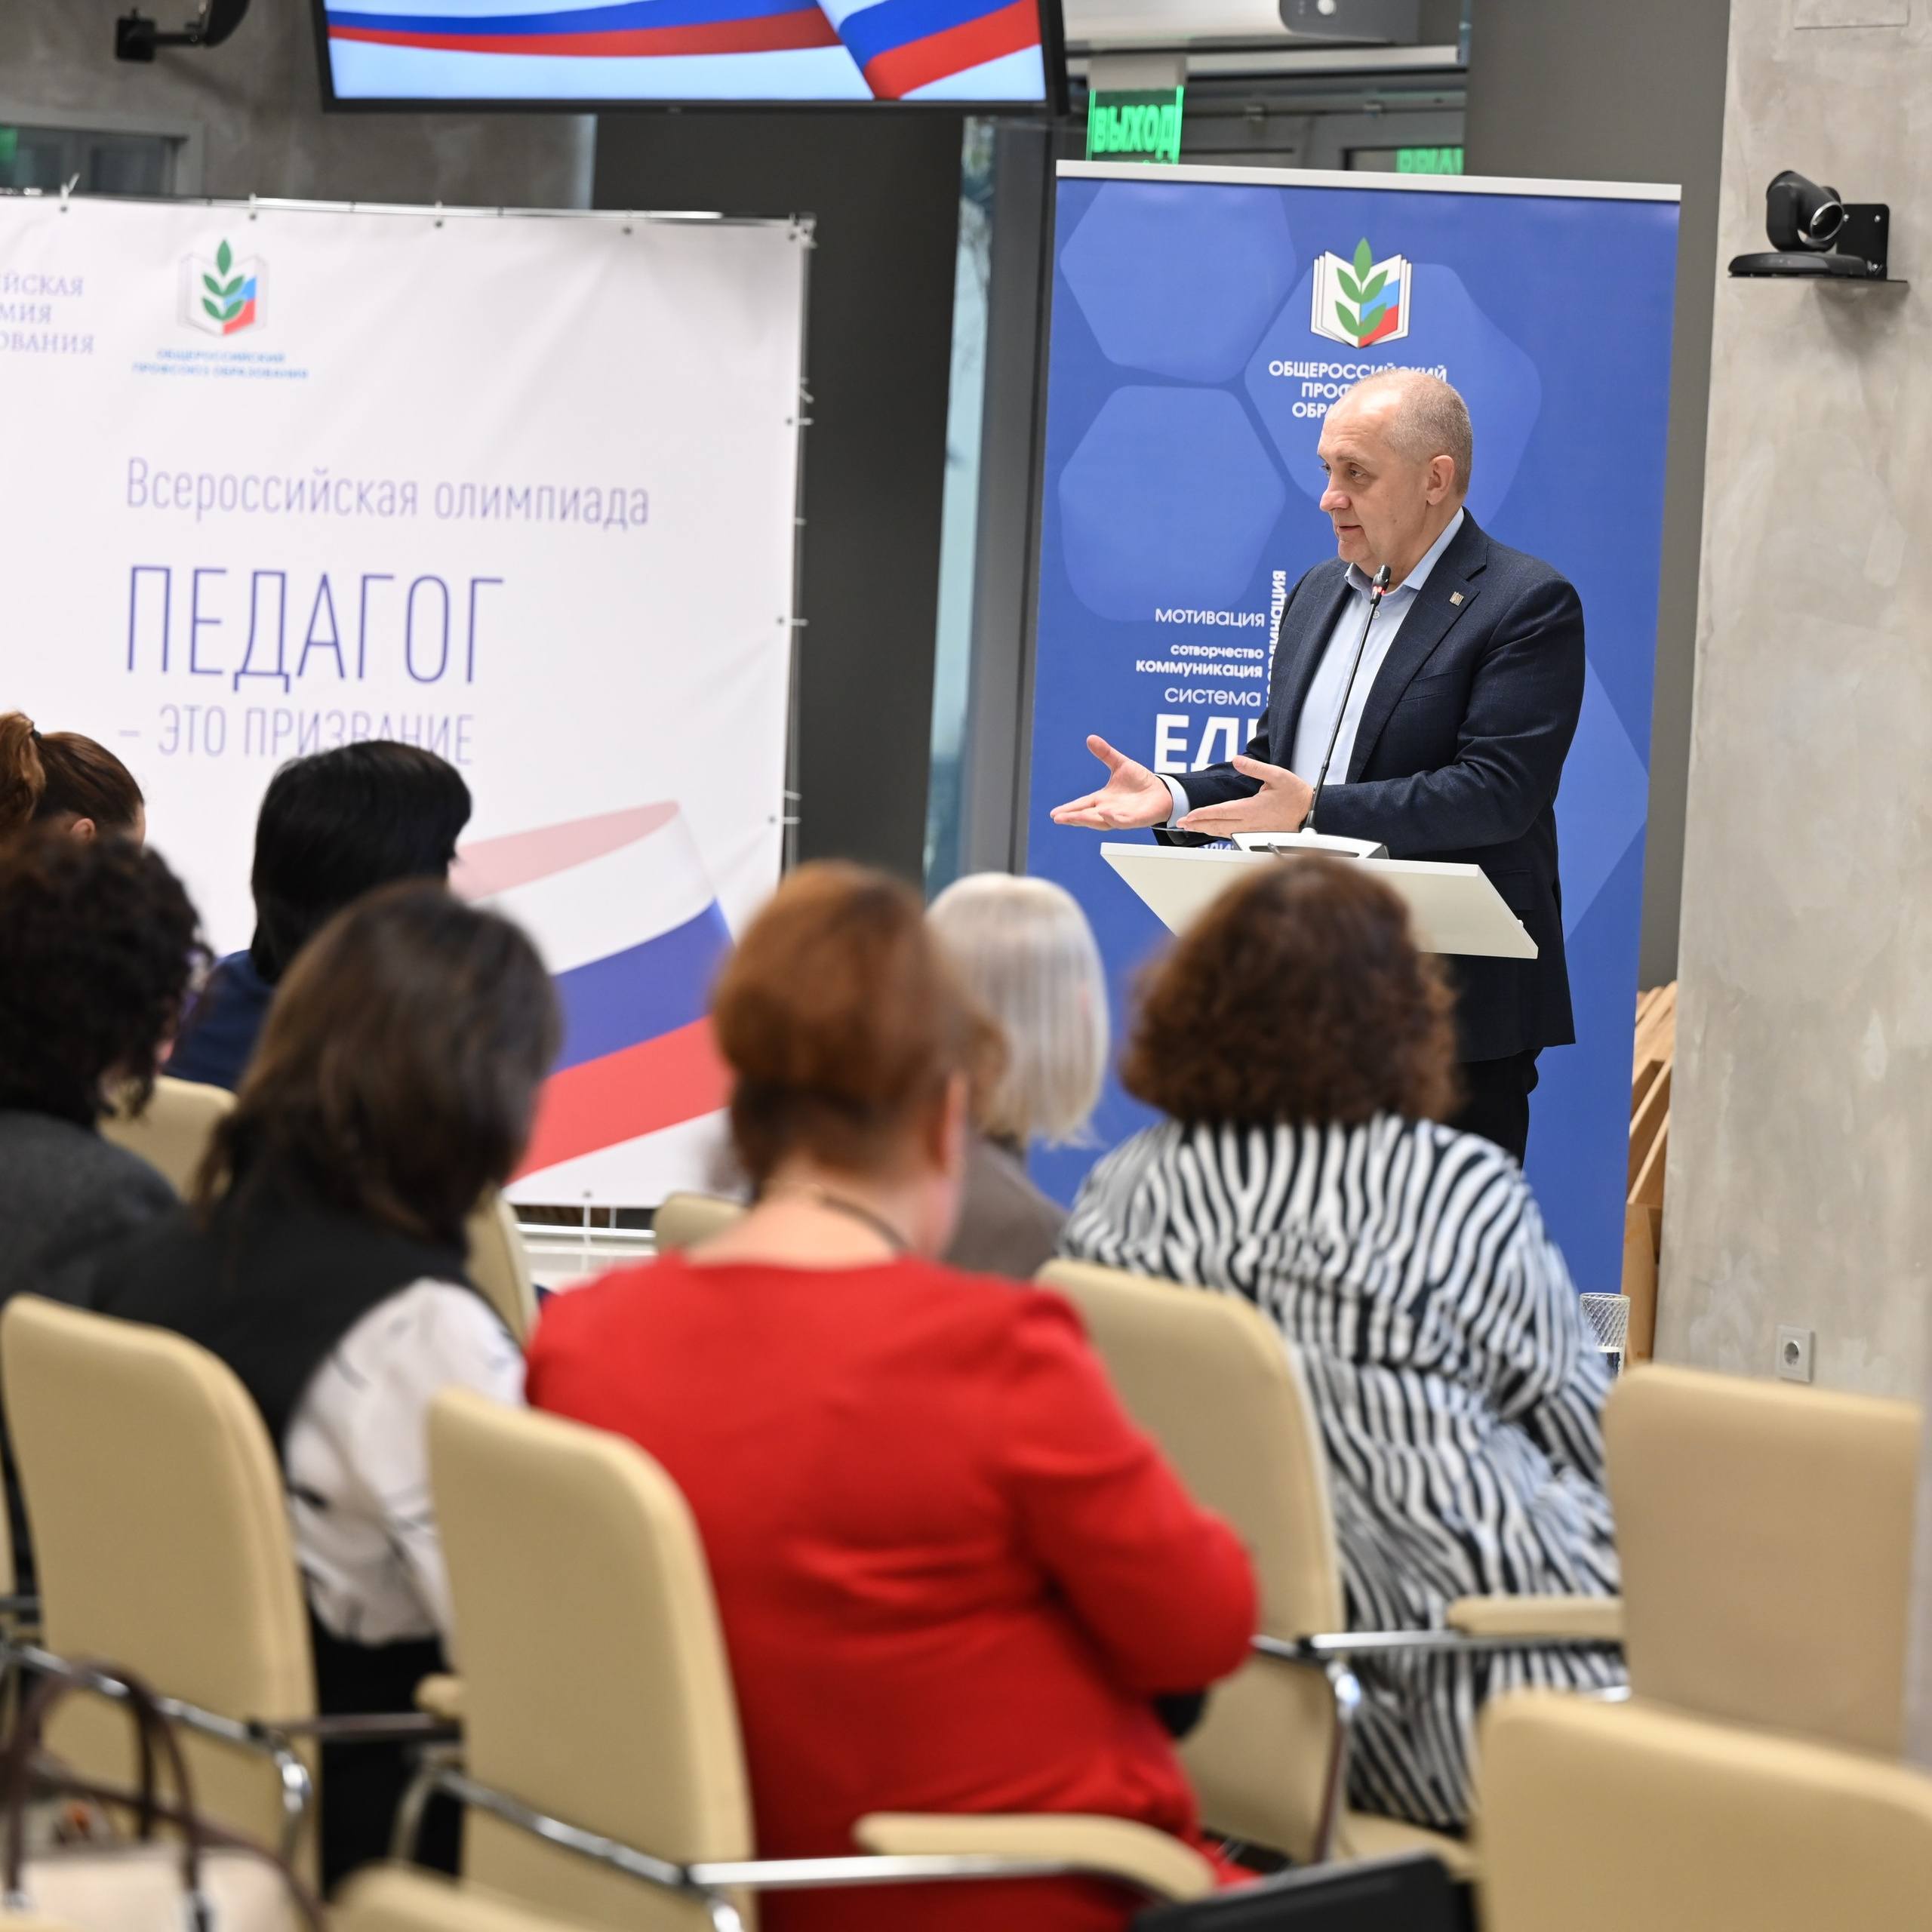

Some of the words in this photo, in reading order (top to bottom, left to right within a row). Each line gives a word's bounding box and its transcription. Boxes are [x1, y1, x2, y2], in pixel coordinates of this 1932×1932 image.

[1092, 104, 1177, 161] ВЫХОД
[0, 268, 84, 297] ЙСКАЯ
[126, 457, 417, 521] Всероссийская
[435, 481, 650, 531] олимпиада
[128, 565, 503, 694] ПЕДАГОГ
[1155, 608, 1265, 627] мотивация
[1136, 660, 1263, 678] коммуникация
[1171, 645, 1264, 659] сотворчество
[1164, 688, 1261, 706] система
[158, 704, 226, 757] ЭТО
[1154, 713, 1260, 774] ЕД
